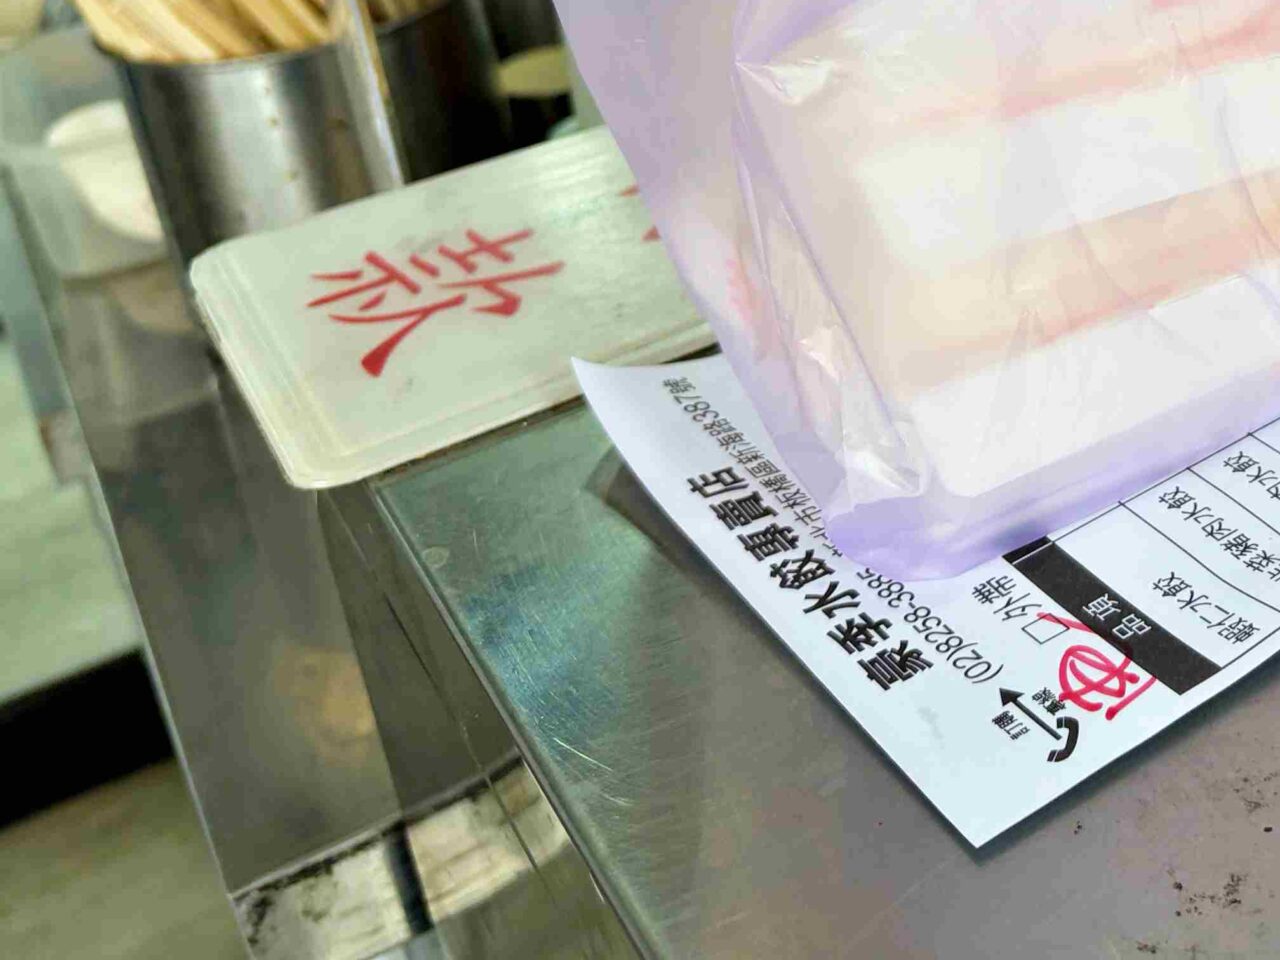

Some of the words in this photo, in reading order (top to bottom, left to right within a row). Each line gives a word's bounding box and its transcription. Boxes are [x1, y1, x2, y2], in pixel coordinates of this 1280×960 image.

[307, 222, 620, 378] 款
[686, 467, 934, 691] 豪季水餃專賣店
[970, 571, 1042, 625] 外帶
[1152, 571, 1260, 644] 蝦仁水餃
[856, 568, 1004, 684] (02)8258-3885
[1082, 592, 1151, 641] 品項
[992, 710, 1030, 740] 訂購
[1032, 687, 1066, 716] 專線
